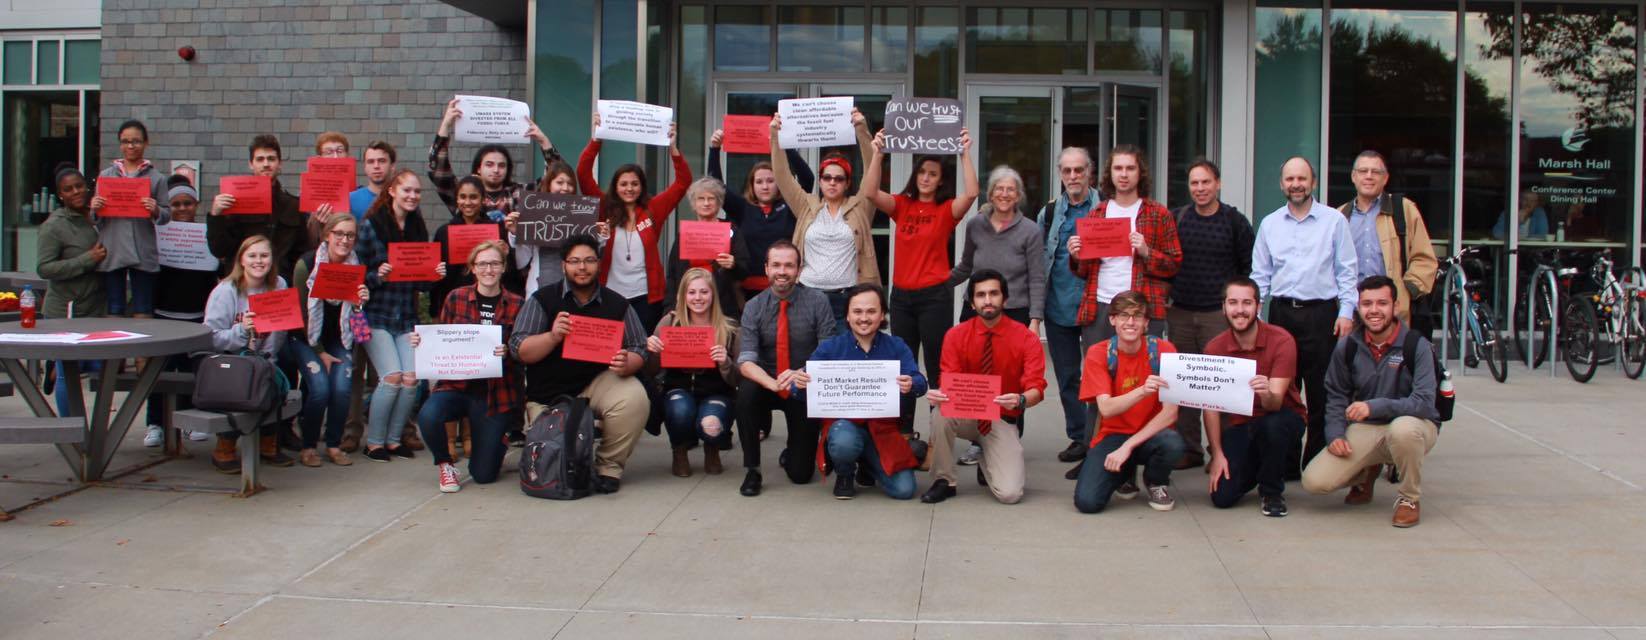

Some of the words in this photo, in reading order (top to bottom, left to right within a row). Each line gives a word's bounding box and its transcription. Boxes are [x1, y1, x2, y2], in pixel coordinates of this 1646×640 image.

[906, 102, 930, 114] we
[931, 102, 960, 115] trust
[1538, 158, 1582, 168] Marsh
[1586, 159, 1611, 169] Hall
[1531, 186, 1583, 194] Conference
[524, 194, 550, 210] Can
[552, 201, 567, 210] we
[571, 201, 596, 211] trust
[1550, 195, 1578, 204] Dining
[437, 329, 461, 337] Slippery
[1179, 355, 1225, 363] Divestment
[1176, 374, 1211, 382] Symbols
[1213, 376, 1235, 384] Don't
[1189, 383, 1221, 391] Matter?
